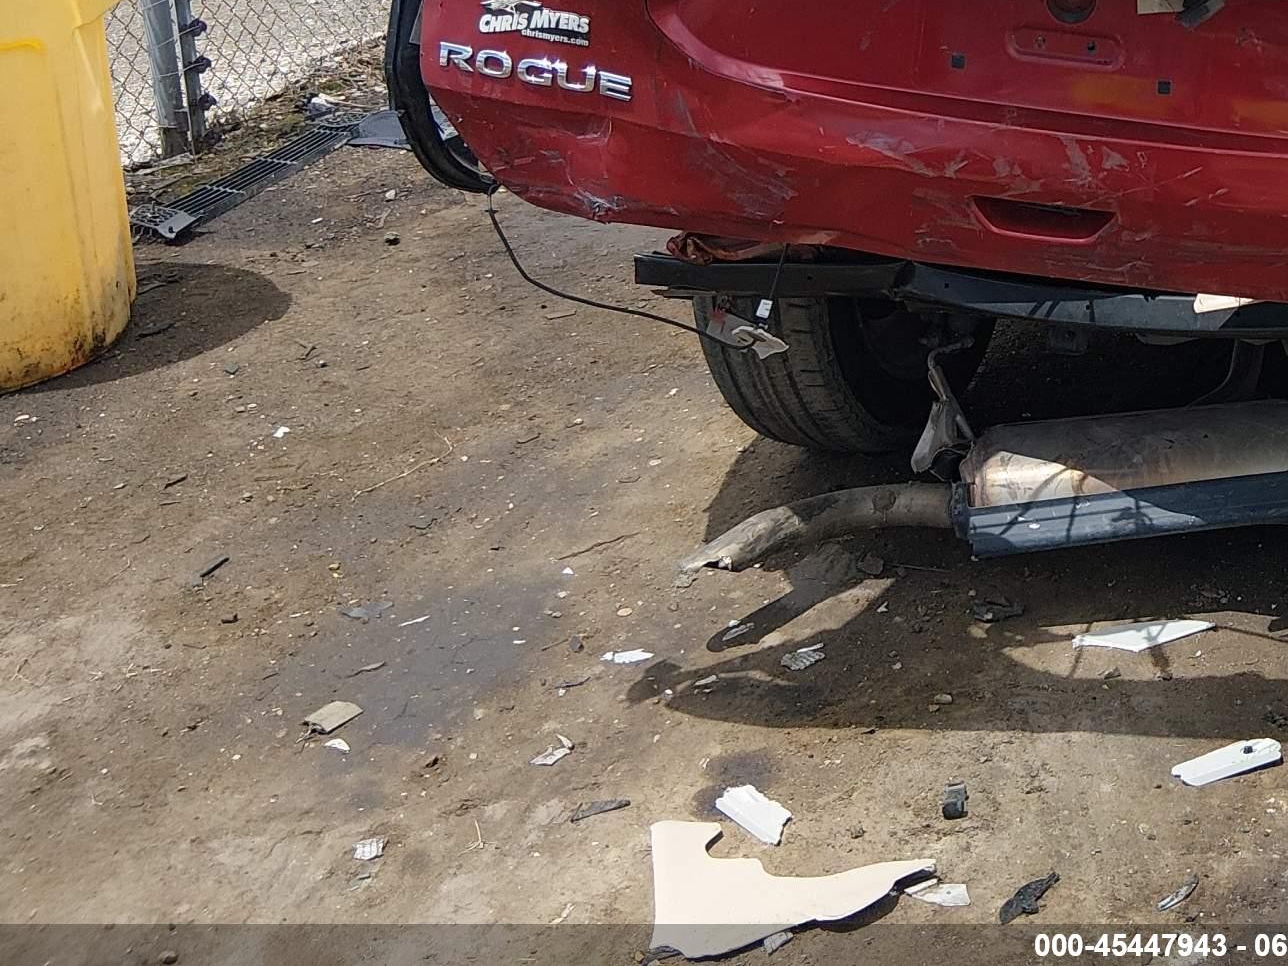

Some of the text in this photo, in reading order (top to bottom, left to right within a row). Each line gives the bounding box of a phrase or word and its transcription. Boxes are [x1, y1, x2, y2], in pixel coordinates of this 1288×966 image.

[479, 9, 590, 34] CHRIS MYERS
[521, 27, 589, 47] chrismyers.com
[439, 41, 633, 102] ROGUE
